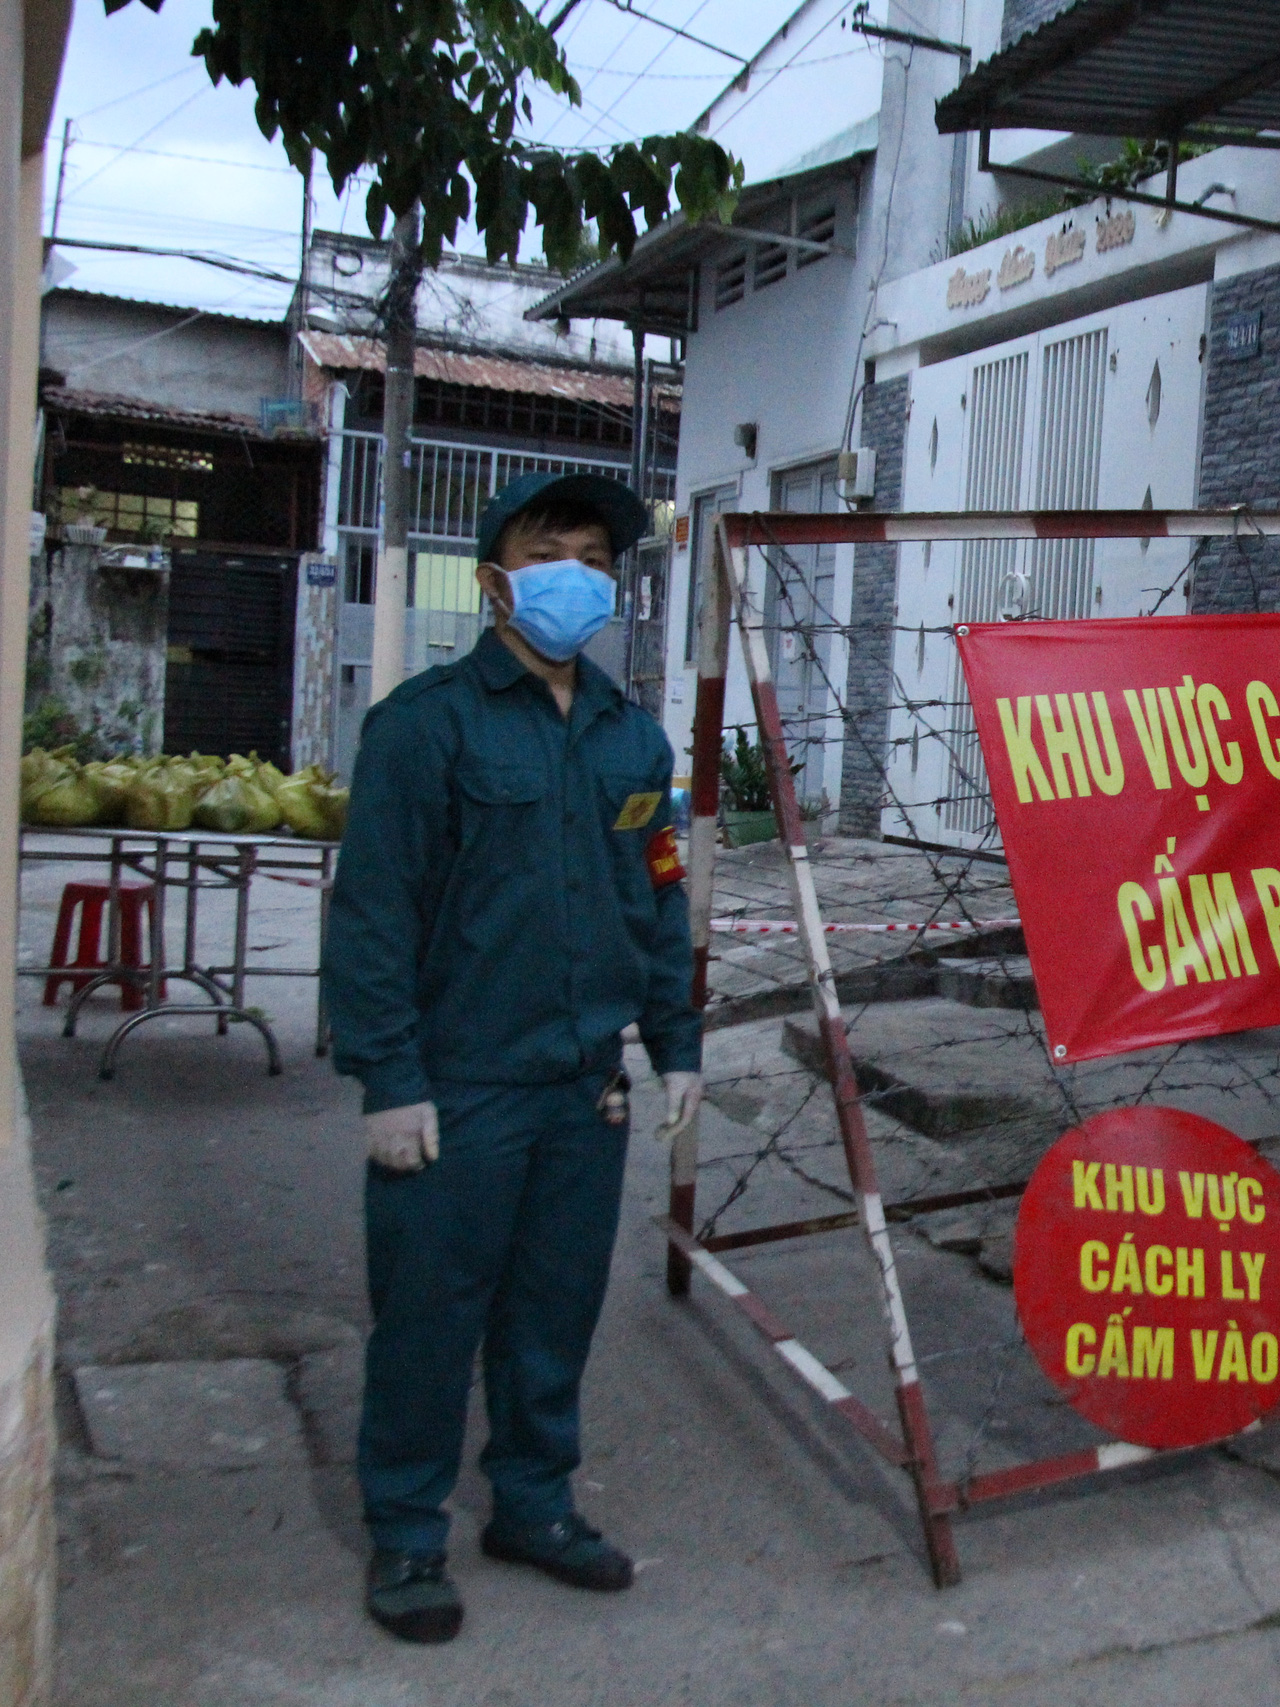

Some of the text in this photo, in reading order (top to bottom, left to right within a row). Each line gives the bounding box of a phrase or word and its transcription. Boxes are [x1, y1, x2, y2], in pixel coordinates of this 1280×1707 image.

[997, 691, 1125, 803] KHU
[1123, 675, 1244, 811] VỰC
[1117, 836, 1260, 992] CẤM
[1072, 1160, 1266, 1231] KHU VỰC
[1080, 1232, 1266, 1301] CÁCH LY
[1065, 1306, 1279, 1385] CẤM VÀO
